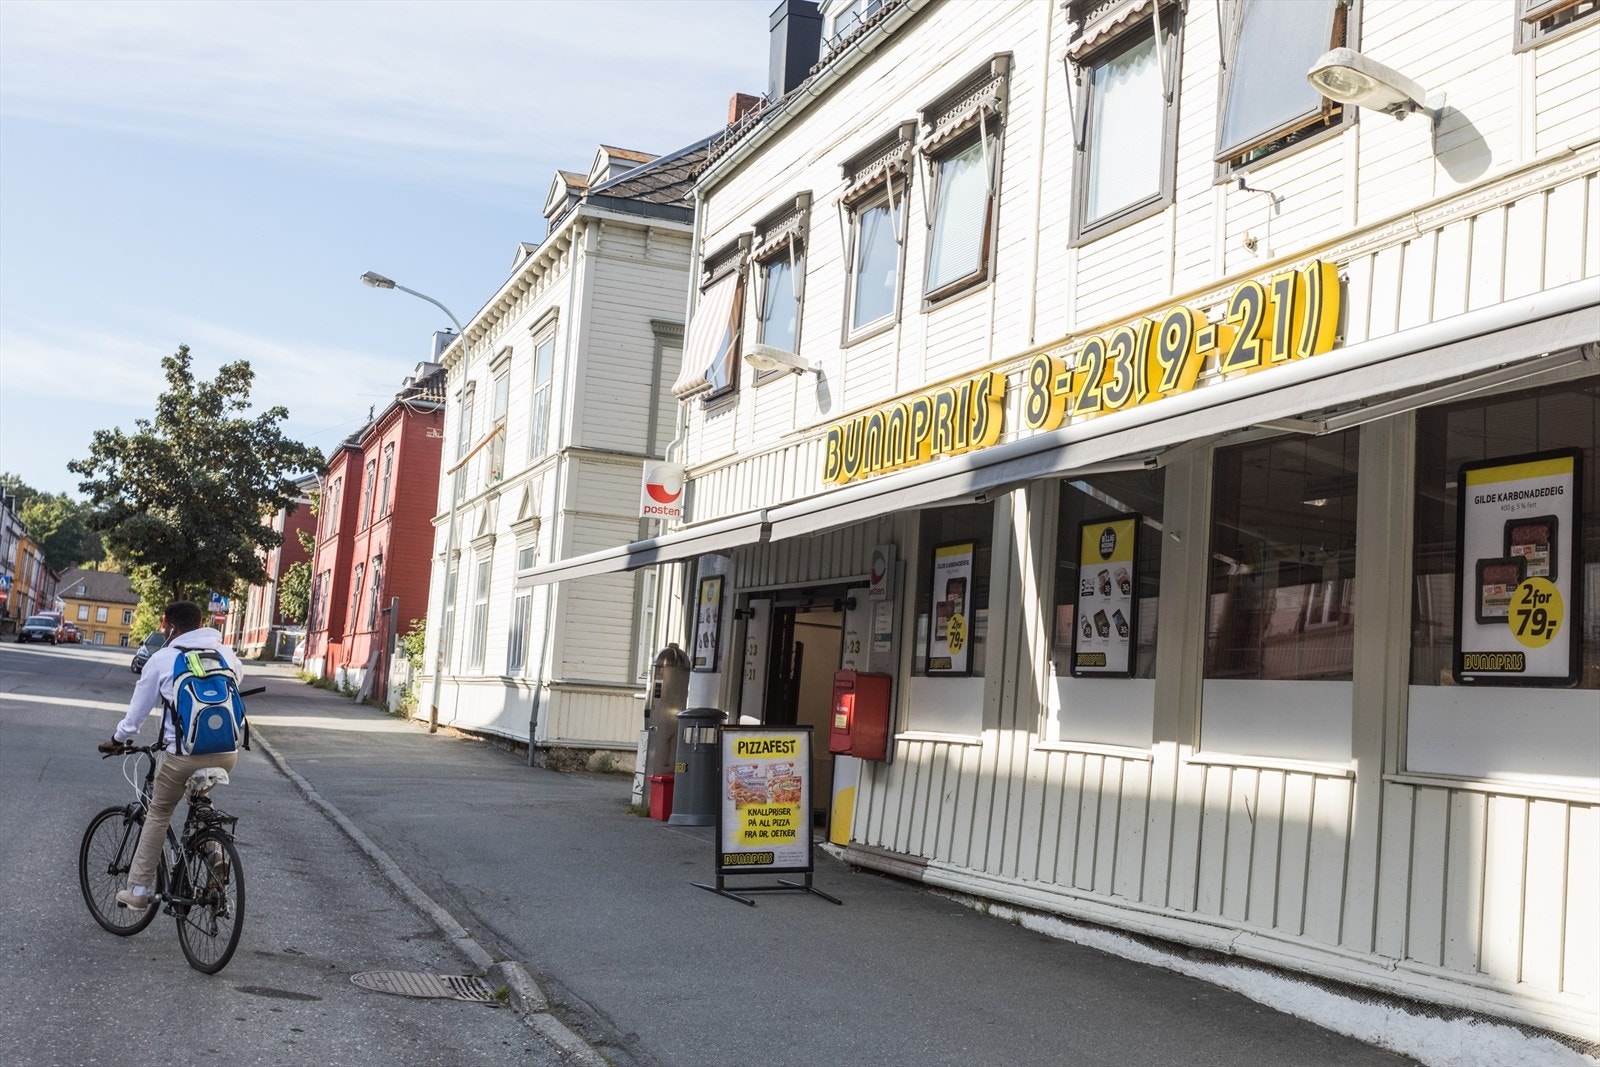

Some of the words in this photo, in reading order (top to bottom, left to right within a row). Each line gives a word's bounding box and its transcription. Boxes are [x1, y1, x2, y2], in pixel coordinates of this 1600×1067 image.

[822, 371, 1002, 485] BUNNPRIS
[1474, 493, 1497, 505] GILDE
[1497, 485, 1564, 502] KARBONADEDEIG
[644, 506, 680, 516] posten
[1464, 653, 1524, 671] BUNNPRIS
[737, 740, 796, 754] PIZZAFEST
[747, 807, 791, 816] KNALLPRISER
[748, 818, 757, 827] PÅ
[759, 818, 770, 827] ALL
[772, 818, 790, 826] PIZZA
[758, 830, 770, 838] DR.
[771, 829, 796, 838] OETKER
[723, 852, 773, 865] BUNNPRIS
